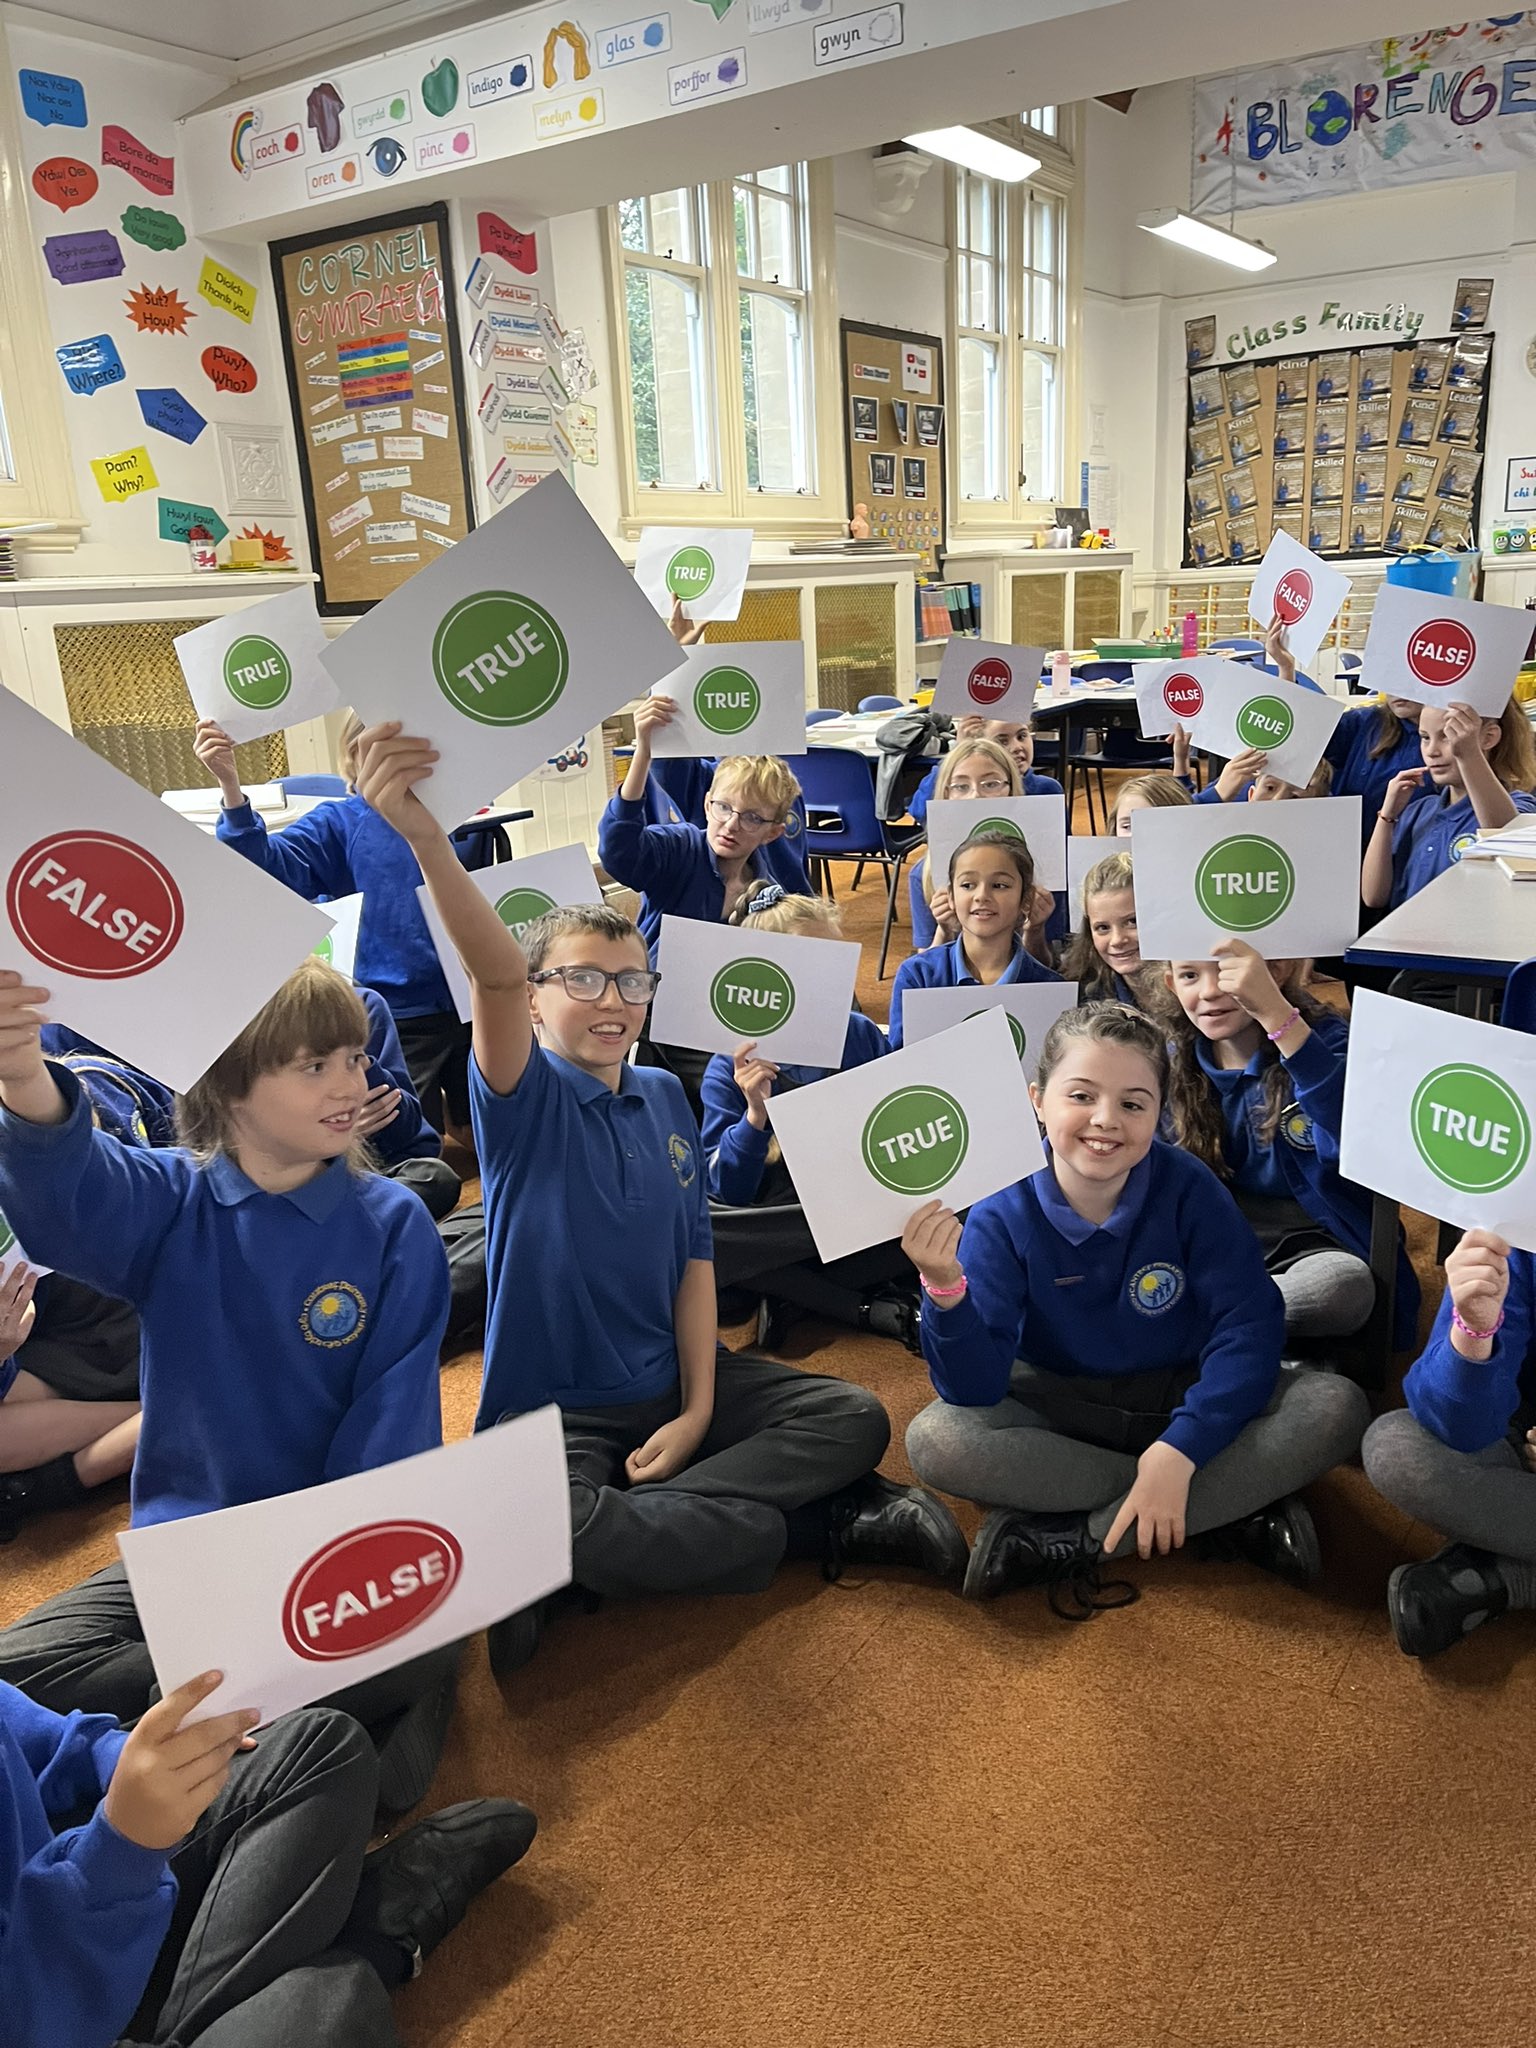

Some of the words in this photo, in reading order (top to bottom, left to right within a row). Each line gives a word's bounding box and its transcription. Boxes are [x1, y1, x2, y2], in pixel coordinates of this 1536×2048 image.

[752, 0, 790, 23] llwyd
[606, 34, 636, 62] glas
[820, 29, 861, 56] gwyn
[471, 77, 503, 95] indigo
[674, 71, 710, 96] porffor
[50, 109, 64, 120] No
[356, 107, 385, 129] gwyrdd
[539, 109, 572, 127] melyn
[119, 141, 143, 160] Bore
[144, 155, 159, 166] da
[255, 141, 280, 160] coch
[419, 141, 444, 165] pinc
[69, 166, 87, 178] Oes
[102, 151, 130, 172] Good
[132, 164, 174, 189] morning
[311, 171, 336, 188] oren
[60, 185, 79, 197] Yes
[489, 224, 501, 239] Pa
[298, 228, 437, 296] CORNEL
[214, 271, 243, 297] Diolch
[494, 286, 514, 299] Dydd
[145, 293, 169, 308] Sut?
[203, 279, 233, 305] Thank
[232, 299, 250, 318] you
[295, 268, 446, 346] CYMRAEG
[143, 311, 176, 328] How?
[491, 315, 511, 327] Dydd
[1226, 313, 1307, 360] Class
[1319, 302, 1424, 341] Family
[213, 346, 248, 371] Pwy?
[494, 343, 515, 355] Dydd
[1279, 357, 1309, 371] Kind
[71, 362, 122, 390] Where?
[211, 367, 248, 393] Who?
[507, 377, 526, 389] Dydd
[502, 408, 522, 420] Dydd
[1358, 400, 1390, 413] Skilled
[1411, 399, 1436, 410] Kind
[1228, 414, 1254, 430] Kind
[506, 440, 525, 451] Dydd
[105, 455, 138, 475] Pam?
[1314, 456, 1344, 468] Skilled
[1404, 452, 1438, 468] Skilled
[113, 475, 144, 494] Why?
[517, 474, 537, 485] Dydd
[1513, 487, 1530, 498] chi
[166, 507, 191, 522] Hwyl
[192, 513, 215, 525] fawr
[1395, 506, 1428, 520] Skilled
[673, 565, 709, 582] TRUE
[1277, 582, 1308, 615] FALSE
[456, 620, 549, 697] TRUE
[1412, 640, 1469, 668] FALSE
[232, 656, 283, 688] TRUE
[972, 674, 1009, 690] FALSE
[703, 691, 751, 711] TRUE
[1167, 687, 1201, 703] FALSE
[1246, 708, 1286, 736] TRUE
[1210, 870, 1280, 897] TRUE
[28, 857, 162, 957] FALSE
[724, 983, 782, 1011] TRUE
[1429, 1101, 1511, 1156] TRUE
[878, 1113, 954, 1165] TRUE
[301, 1549, 447, 1639] FALSE
